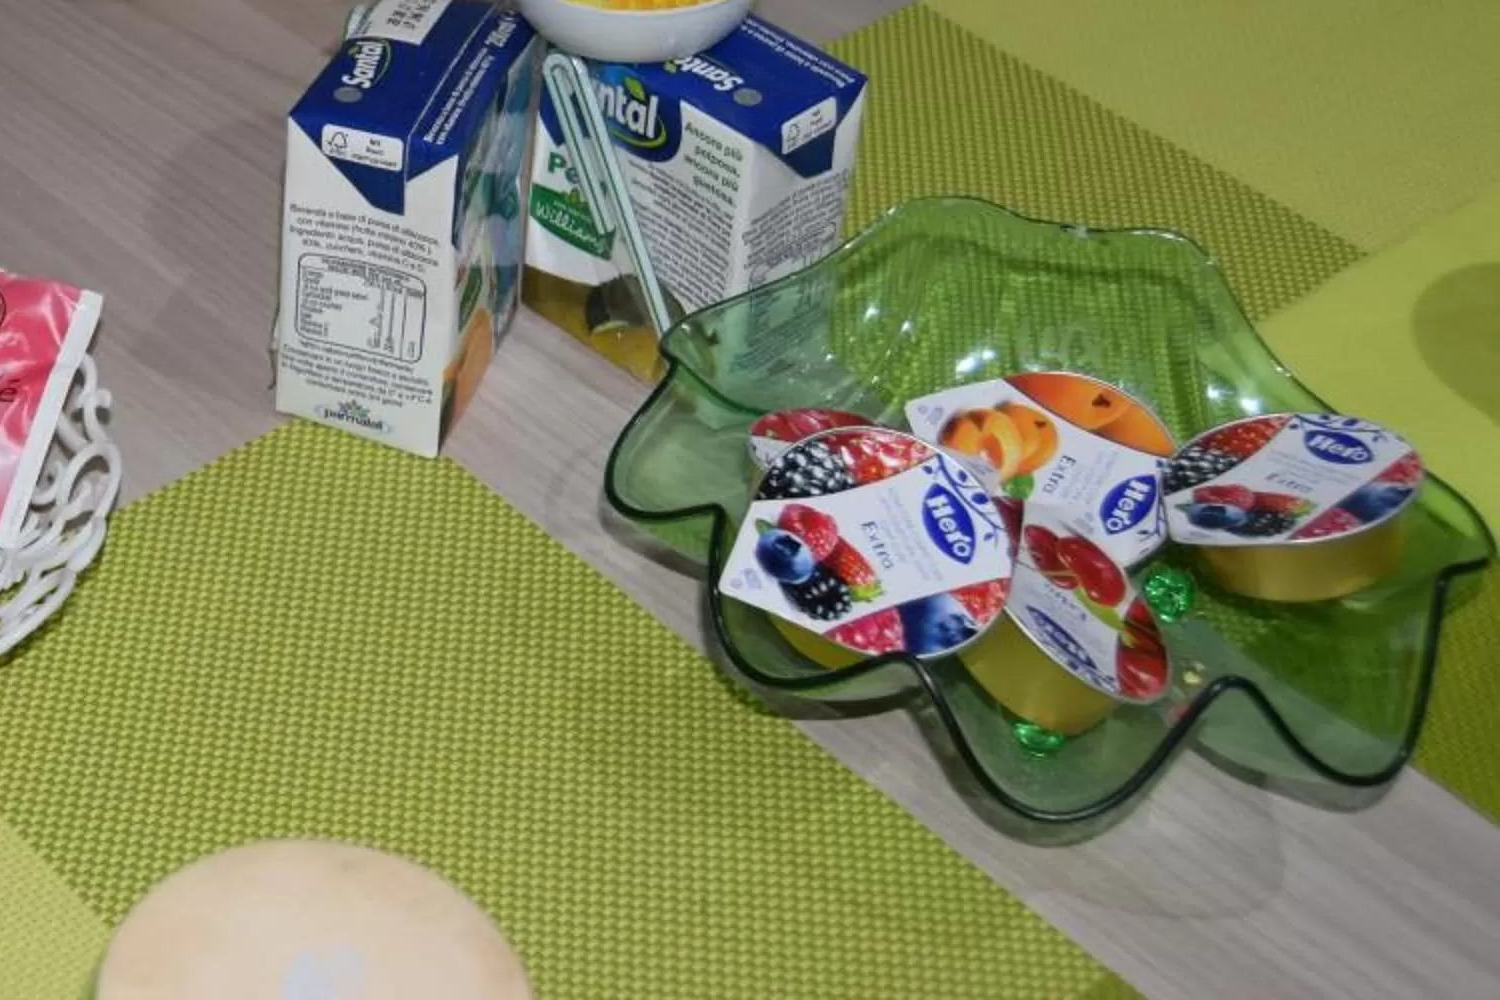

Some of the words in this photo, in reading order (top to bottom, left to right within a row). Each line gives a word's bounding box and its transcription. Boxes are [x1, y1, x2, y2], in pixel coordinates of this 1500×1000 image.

[598, 80, 660, 138] ntal
[1310, 432, 1369, 464] Hero
[1041, 454, 1078, 496] Extra
[924, 494, 972, 558] Hero
[1105, 478, 1153, 532] Hero
[860, 520, 895, 570] Extra
